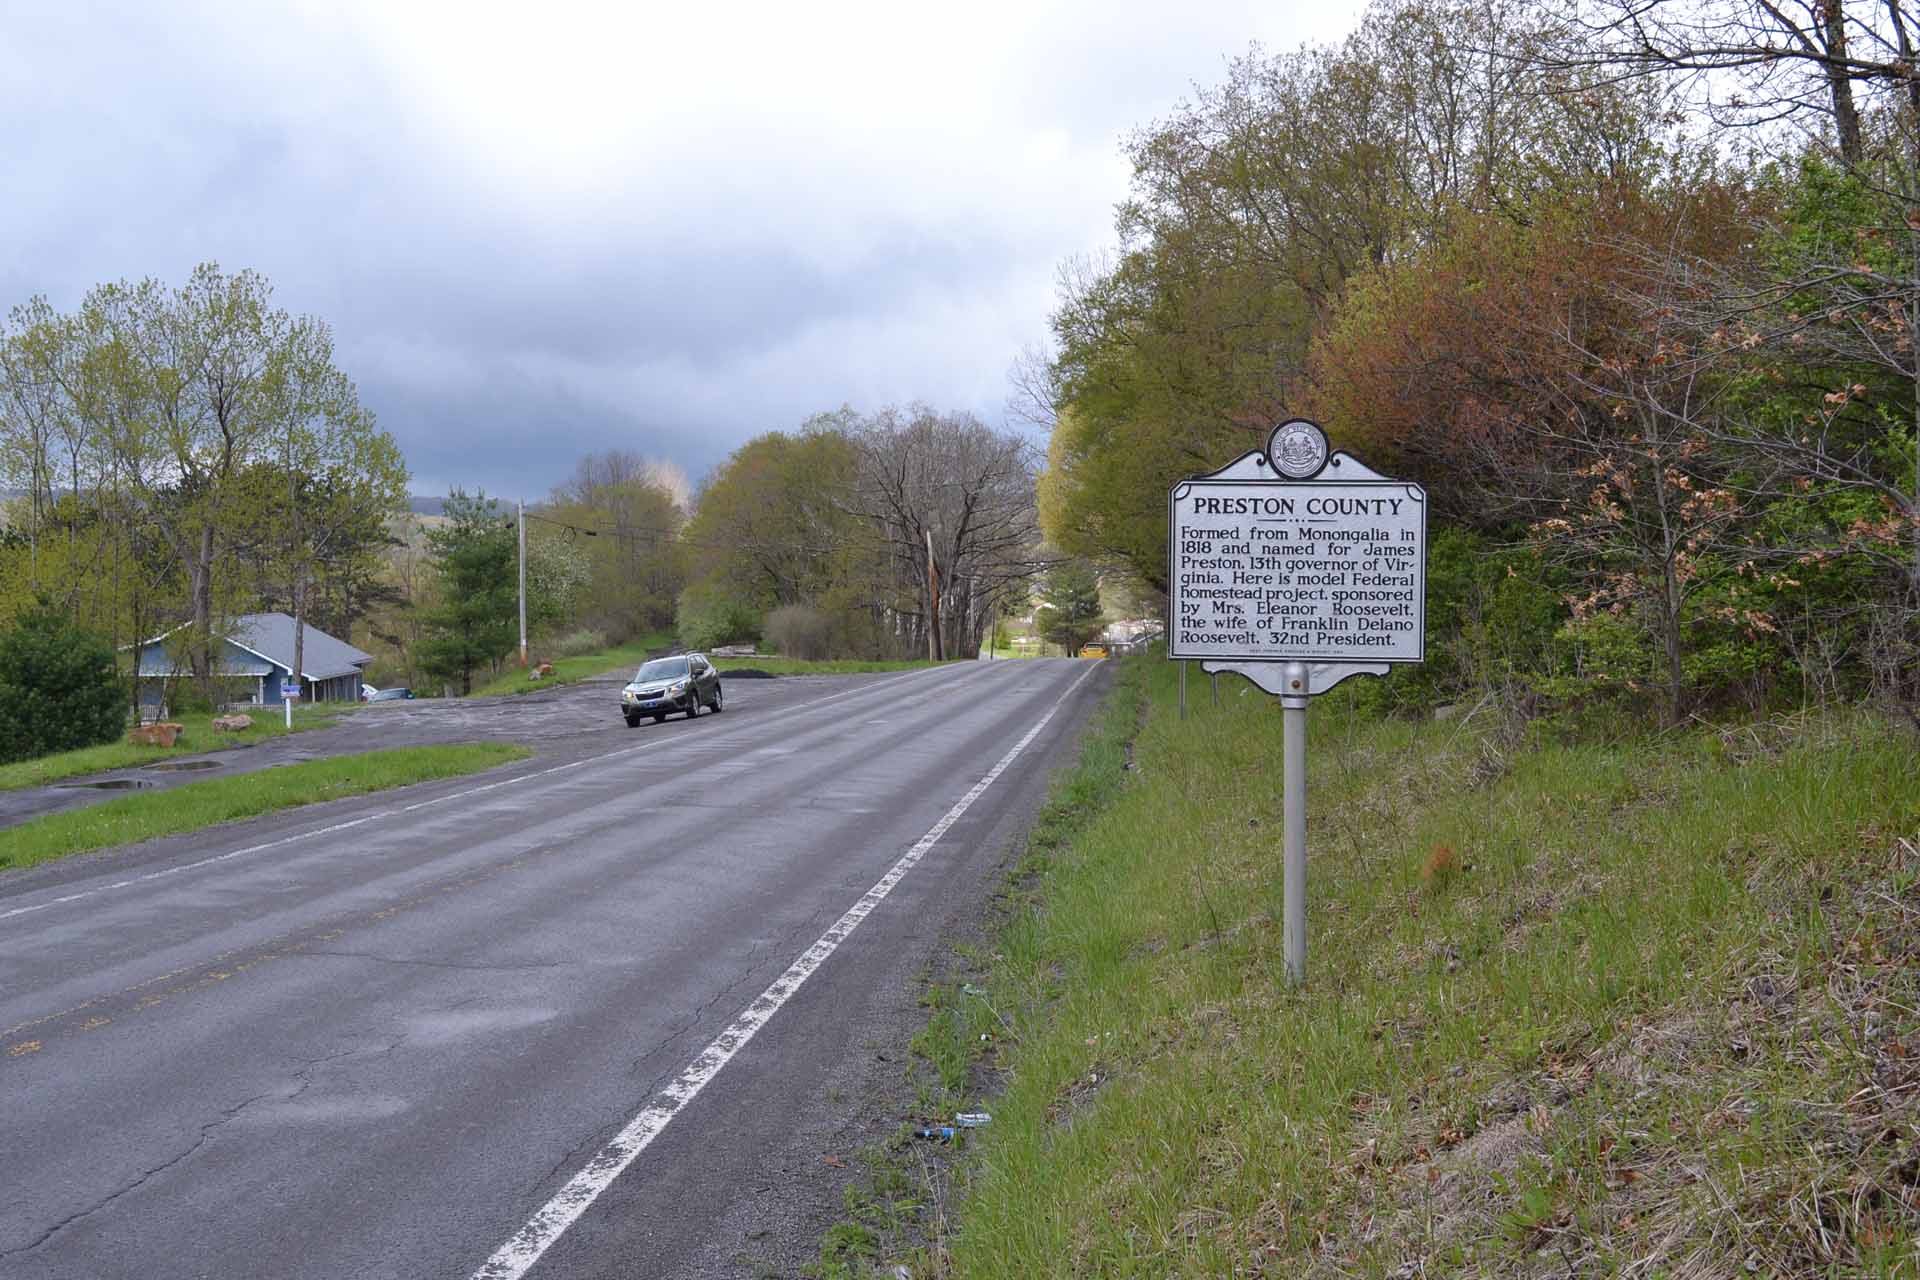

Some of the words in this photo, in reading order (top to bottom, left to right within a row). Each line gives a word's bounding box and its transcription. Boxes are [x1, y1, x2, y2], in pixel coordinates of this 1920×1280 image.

[1194, 498, 1294, 515] PRESTON
[1307, 499, 1403, 515] COUNTY
[1182, 526, 1239, 540] Formed
[1250, 527, 1288, 540] from
[1299, 528, 1389, 544] Monongalia
[1401, 529, 1414, 541] in
[1182, 541, 1212, 554] 1818
[1222, 542, 1250, 555] and
[1262, 543, 1315, 555] named
[1328, 543, 1351, 555] for
[1363, 543, 1414, 555] James
[1250, 557, 1280, 570] 13th
[1286, 560, 1358, 574] governor
[1362, 558, 1379, 570] of
[1385, 558, 1415, 571] Vir-
[1181, 571, 1223, 588] ginia.
[1233, 572, 1273, 584] Here
[1280, 572, 1290, 584] is
[1298, 573, 1344, 585] model
[1353, 574, 1414, 586] Federal
[1181, 586, 1261, 599] homestead
[1332, 588, 1413, 604] sponsored
[1181, 601, 1200, 615] by
[1213, 602, 1245, 614] Mrs.
[1257, 603, 1317, 615] Eleanor
[1181, 616, 1206, 628] the
[1214, 617, 1247, 629] wife
[1257, 617, 1273, 630] of
[1282, 618, 1348, 630] Franklin
[1358, 618, 1413, 631] Delano
[1270, 632, 1309, 645] 32nd
[1317, 633, 1395, 646] President.
